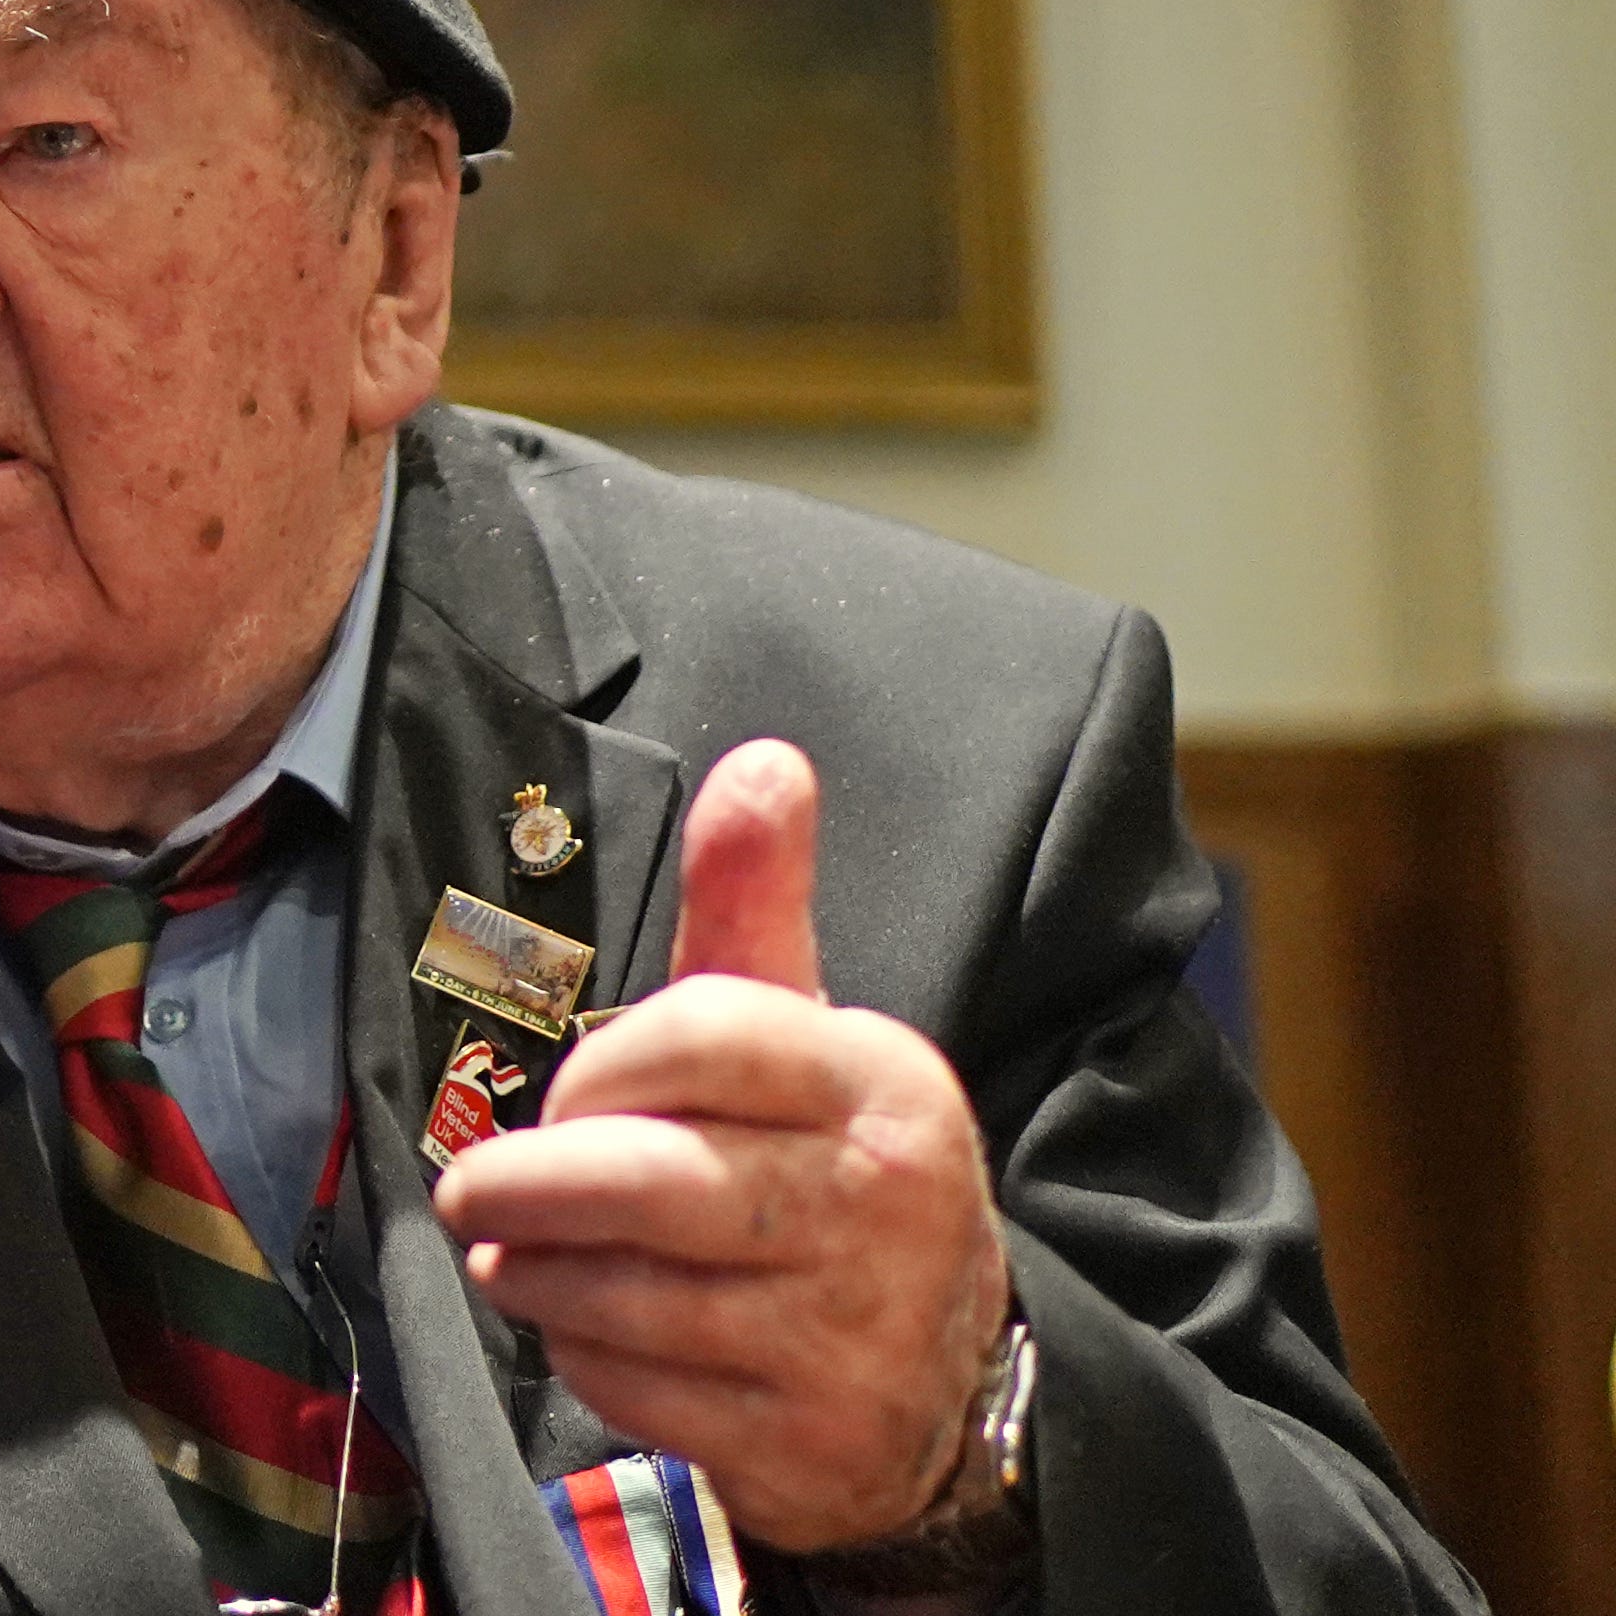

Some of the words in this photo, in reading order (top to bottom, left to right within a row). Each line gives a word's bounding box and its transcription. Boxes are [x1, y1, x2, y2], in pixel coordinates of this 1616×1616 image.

[494, 999, 524, 1018] JUNE
[445, 1087, 480, 1124] Blind
[434, 1118, 456, 1147] UK
[442, 1102, 482, 1146] Vetera
[430, 1142, 453, 1166] Me
